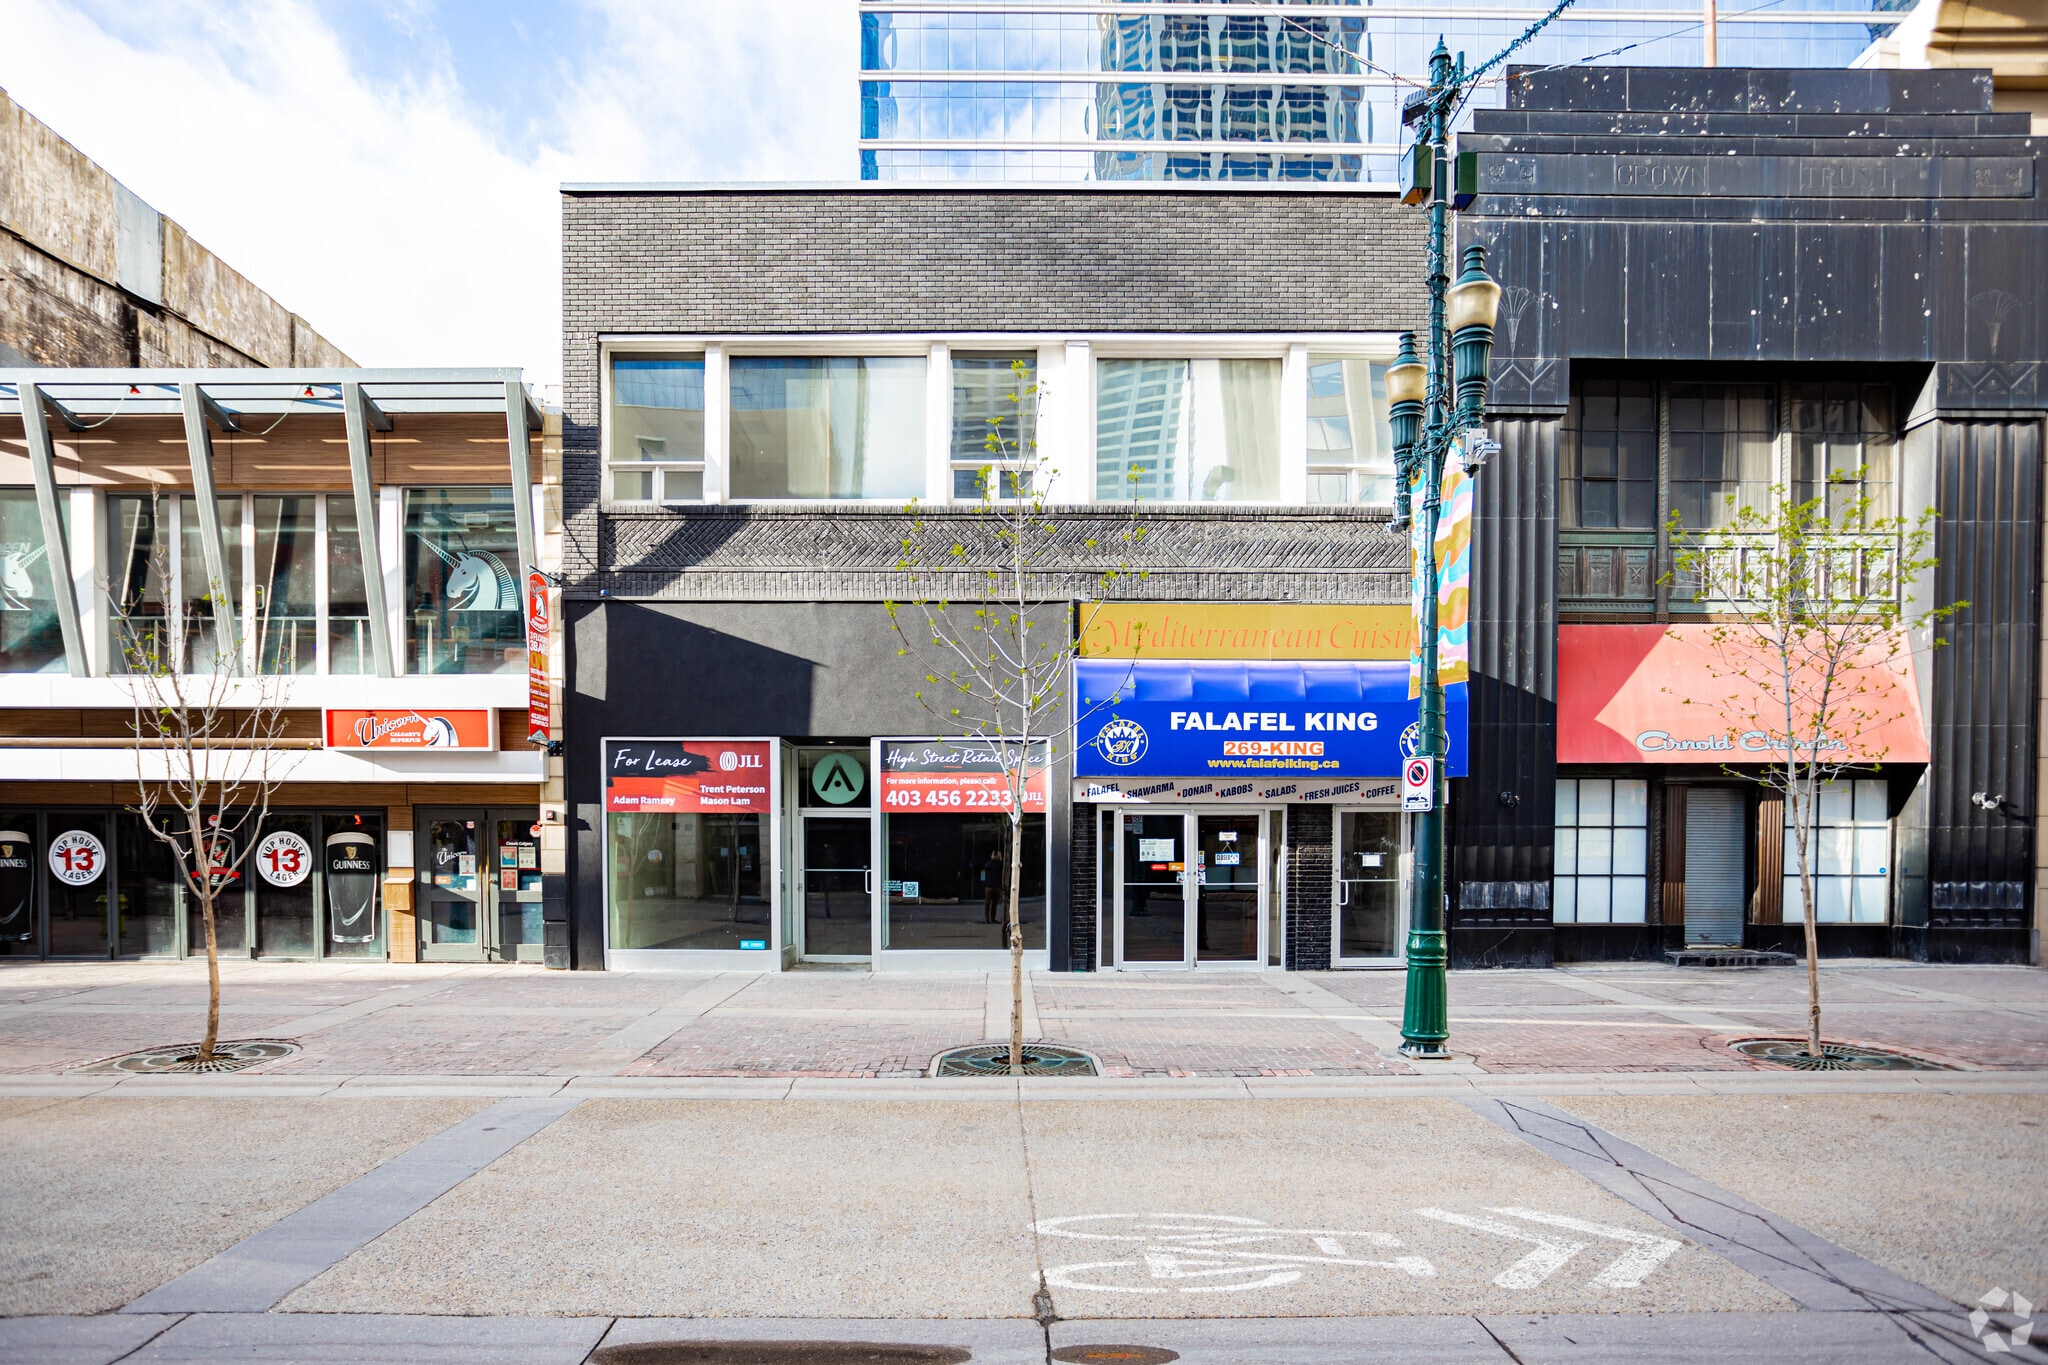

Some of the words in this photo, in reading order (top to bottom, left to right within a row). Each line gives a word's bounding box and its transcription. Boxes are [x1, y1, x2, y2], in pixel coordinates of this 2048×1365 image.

[1617, 164, 1708, 187] CROWN
[1801, 166, 1888, 188] TRUST
[1092, 614, 1321, 648] Mediterranean
[1170, 711, 1296, 731] FALAFEL
[1305, 712, 1378, 731] KING
[354, 713, 421, 747] Unicorn
[1224, 741, 1324, 755] 269-KING
[1635, 729, 1736, 752] Arnold
[613, 748, 641, 769] For
[645, 749, 692, 771] Lease
[737, 754, 763, 768] JLL
[885, 748, 918, 769] High
[920, 748, 960, 766] Street
[960, 749, 1003, 766] Retail
[1006, 748, 1044, 767] Spce
[1207, 758, 1340, 770] www.falafelking.ca
[886, 777, 898, 785] For
[917, 777, 959, 786] information,
[959, 777, 982, 786] please
[982, 777, 997, 785] call:
[700, 785, 724, 794] Trent
[725, 785, 766, 795] Peterson
[885, 790, 921, 806] 403
[925, 790, 962, 806] 456
[965, 790, 1012, 806] 2233
[1086, 782, 1120, 798] FALAFEL
[1126, 781, 1175, 800] SHAWARMA
[1182, 783, 1213, 799] DONAIR
[1220, 783, 1253, 799] KABOBS
[1265, 784, 1297, 800] SALADS
[1304, 787, 1330, 802] FRESH
[1331, 781, 1360, 797] JUICES
[1366, 784, 1395, 799] COFFEE
[613, 796, 639, 805] Adam
[640, 796, 676, 807] Ramsay
[700, 797, 729, 806] Mason
[730, 797, 750, 806] Lam
[54, 839, 69, 858] HOP
[71, 836, 100, 857] HOUSE
[262, 840, 276, 858] HOP
[279, 837, 306, 858] HOUSE
[0, 858, 28, 868] INNESS
[60, 847, 94, 871] 13
[267, 848, 301, 872] 13
[332, 859, 371, 870] GUINNESS
[436, 849, 468, 866] Unicorn
[62, 868, 94, 880] LAGER
[269, 869, 299, 882] LAGER
